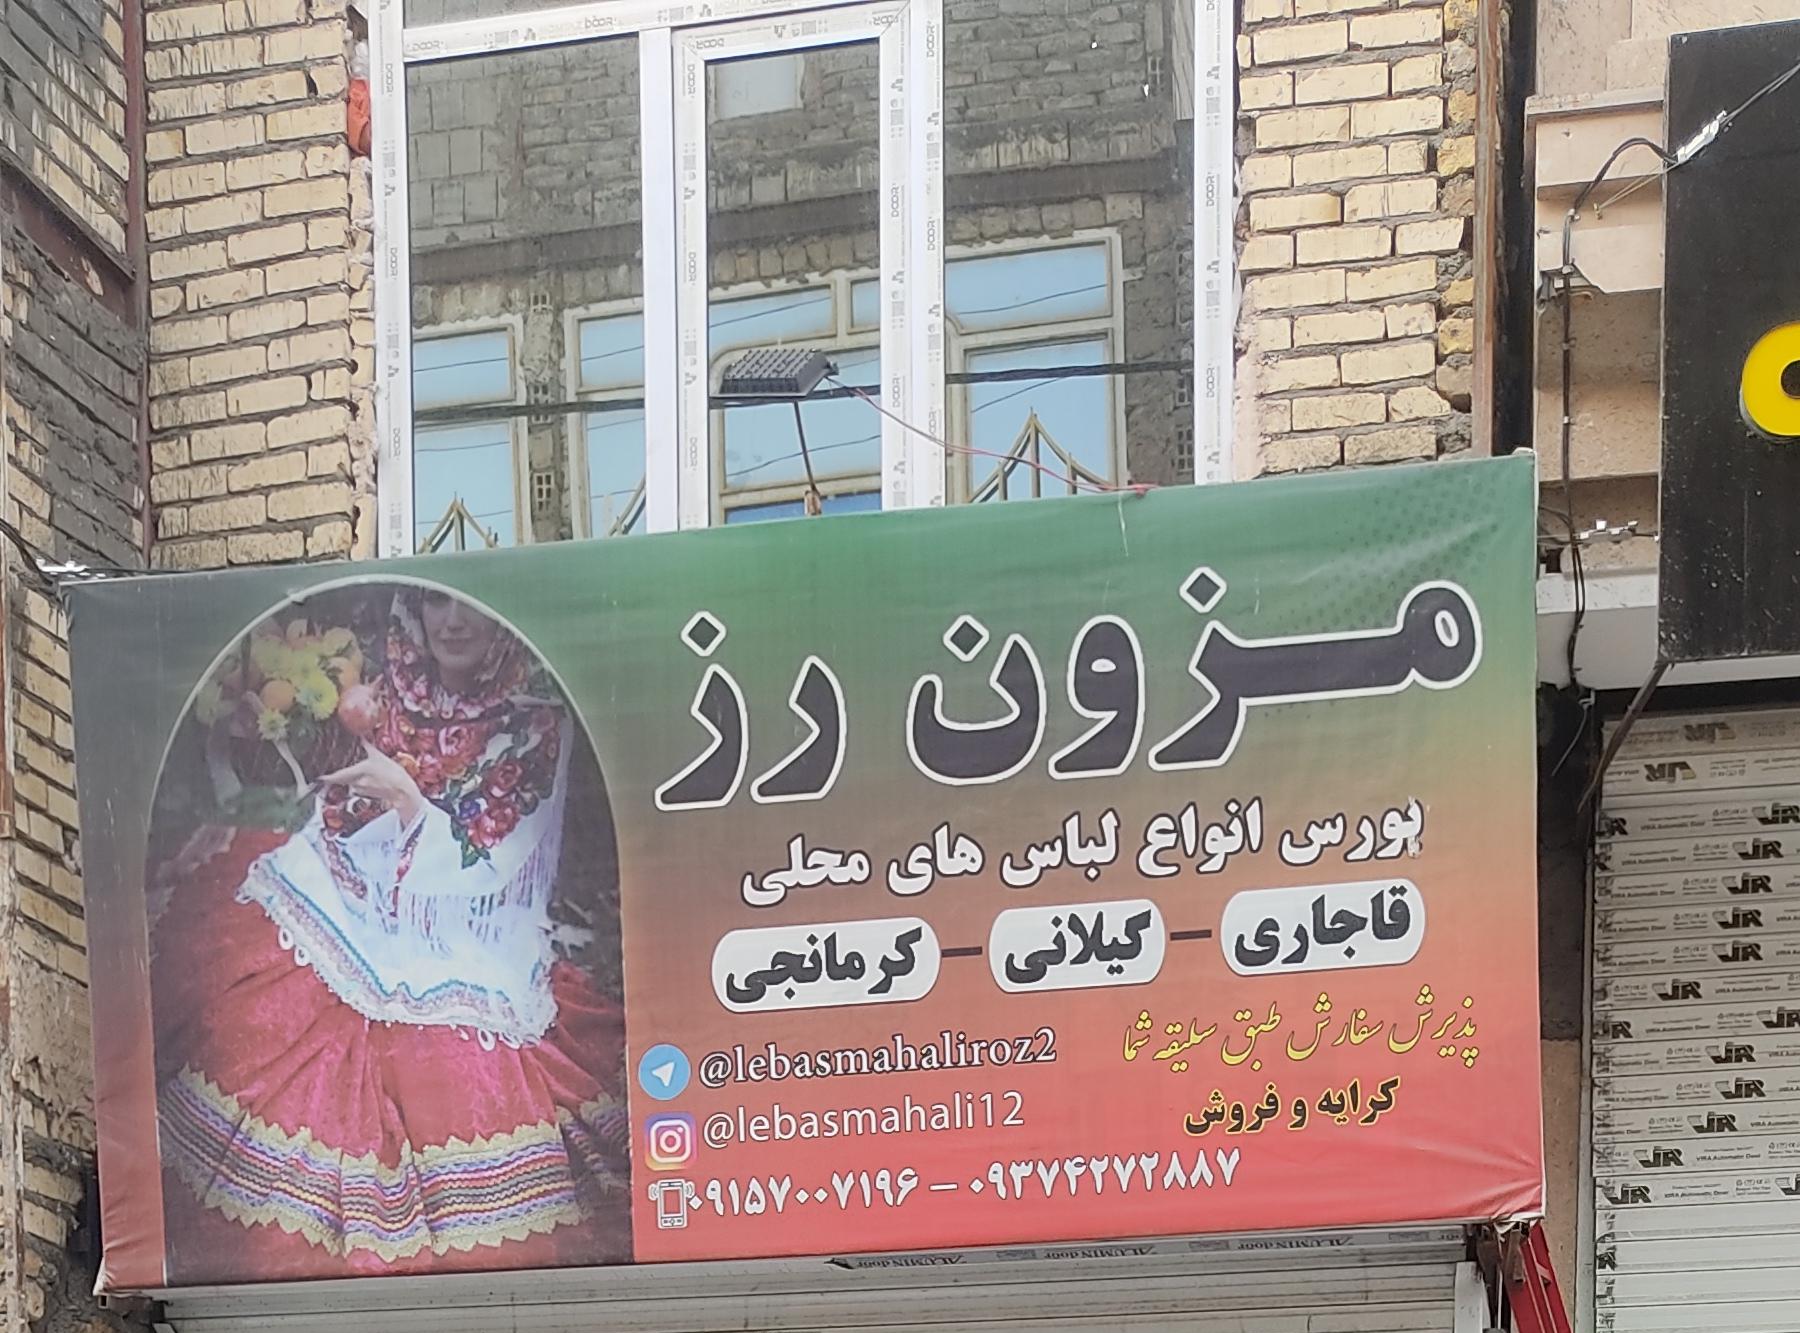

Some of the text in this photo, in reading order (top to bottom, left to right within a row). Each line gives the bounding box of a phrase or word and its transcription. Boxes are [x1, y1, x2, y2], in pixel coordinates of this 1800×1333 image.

[654, 566, 1483, 811] مزون رز
[741, 833, 872, 907] محلی
[887, 821, 985, 896] های
[1000, 807, 1120, 888] لباس
[1137, 797, 1263, 877] انواع
[1235, 885, 1411, 967] قاجاری
[726, 926, 922, 1004] کرمانجی
[699, 1027, 1057, 1088] @lebasmahaliroz2
[1123, 984, 1479, 1072] پذیرش سفارش طبق سلیقه شما
[703, 1091, 1025, 1148] @lebasmahali12
[1184, 1075, 1401, 1136] کرایه و فروش
[688, 1167, 919, 1217] ۰۹۱۵۷۰۰۷۱۹۶
[968, 1147, 1241, 1201] ۰۹۳۷۴۲۷۲۸۸۷
